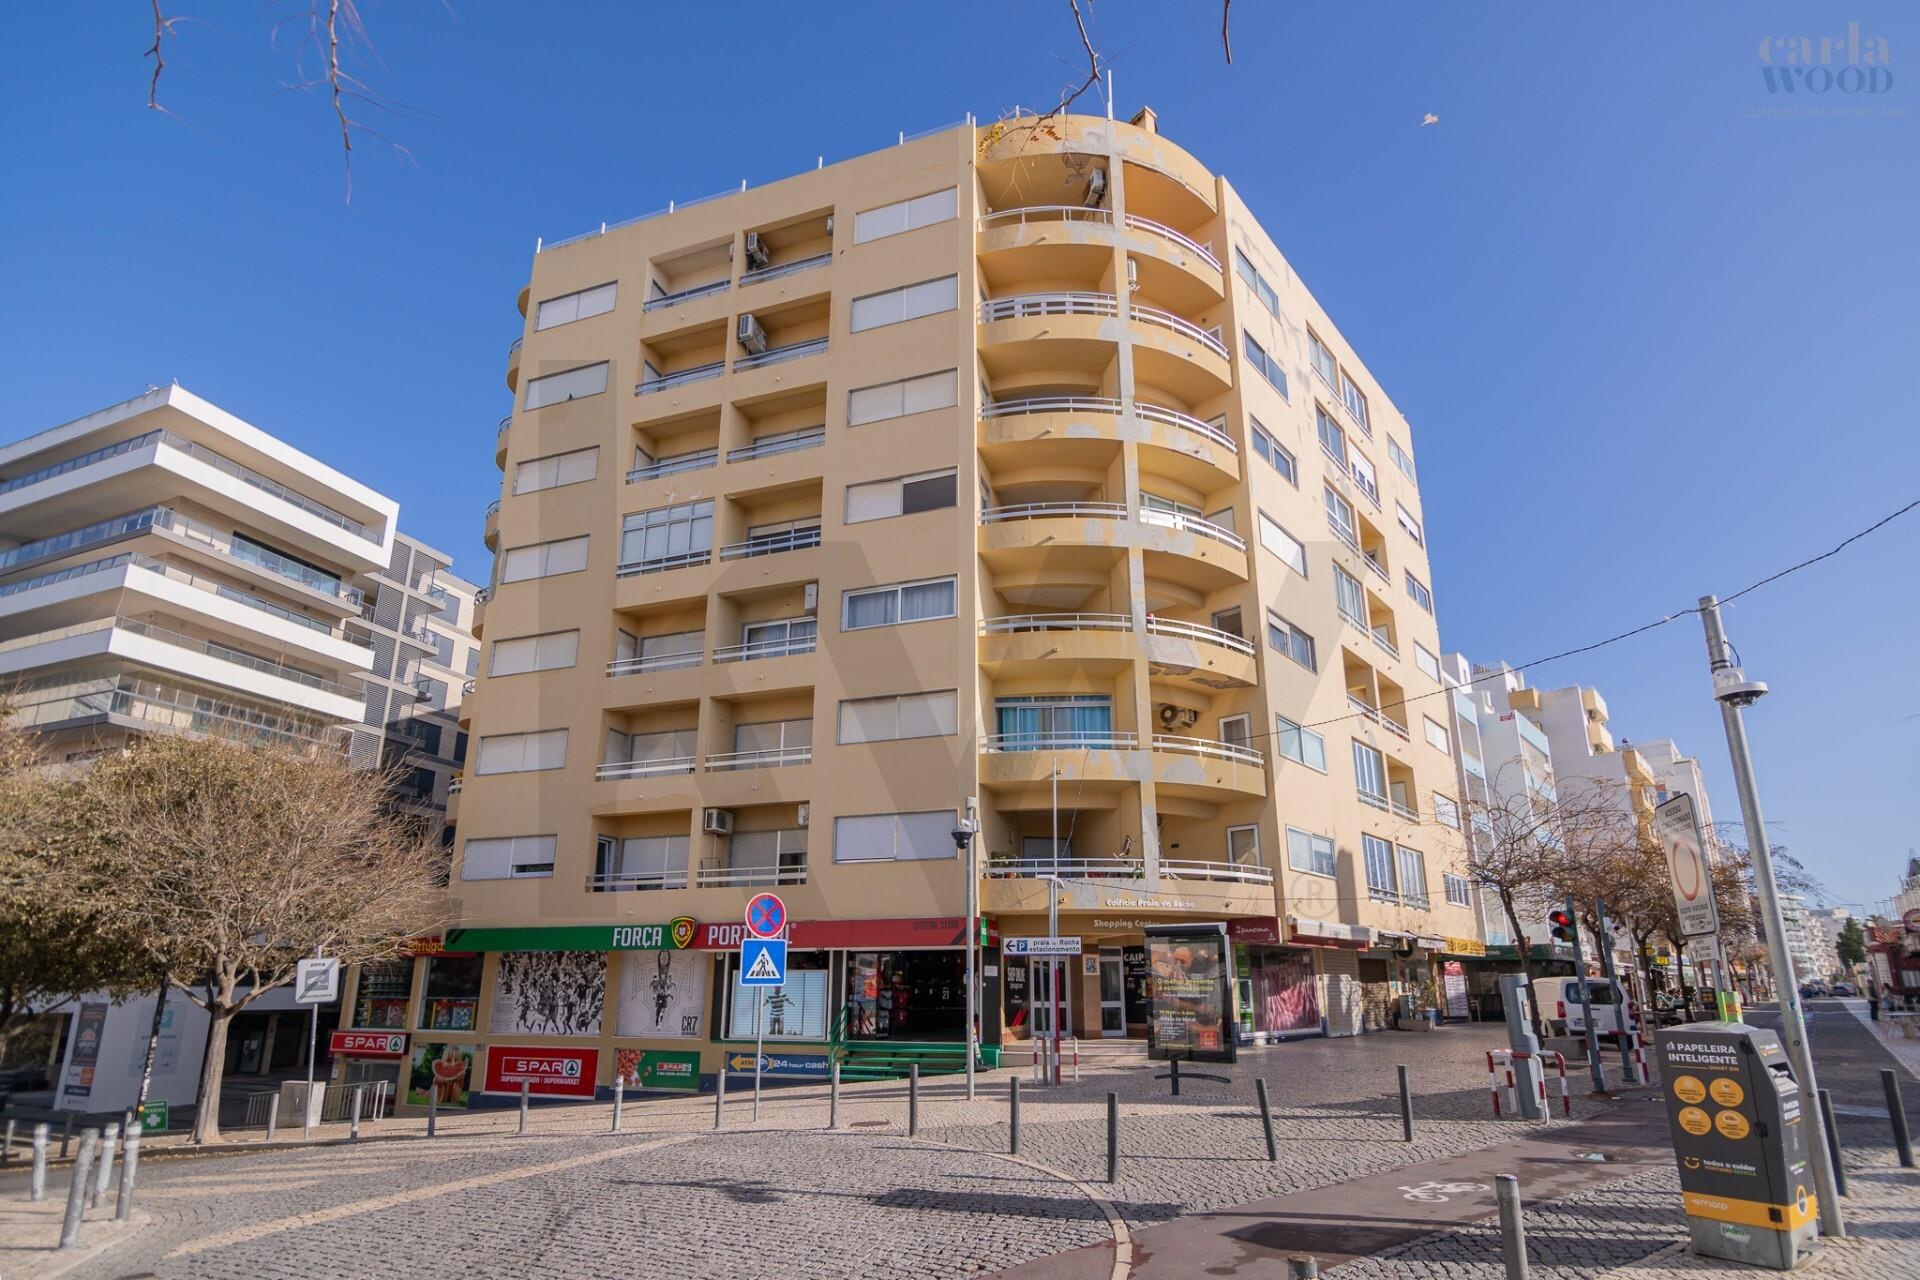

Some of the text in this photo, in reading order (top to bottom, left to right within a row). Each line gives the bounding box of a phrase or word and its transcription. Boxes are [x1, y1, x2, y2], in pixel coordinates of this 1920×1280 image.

[1093, 919, 1133, 928] Shopping
[612, 926, 663, 948] FORÇA
[681, 1015, 698, 1031] CR7
[343, 1036, 387, 1049] SPAR
[1676, 1043, 1737, 1054] PAPELEIRA
[774, 1060, 788, 1068] 24
[805, 1061, 829, 1069] cash
[1667, 1053, 1739, 1065] INTELIGENTE
[516, 1061, 563, 1073] SPAR
[663, 1063, 683, 1071] SPAR
[1703, 1159, 1724, 1168] todos
